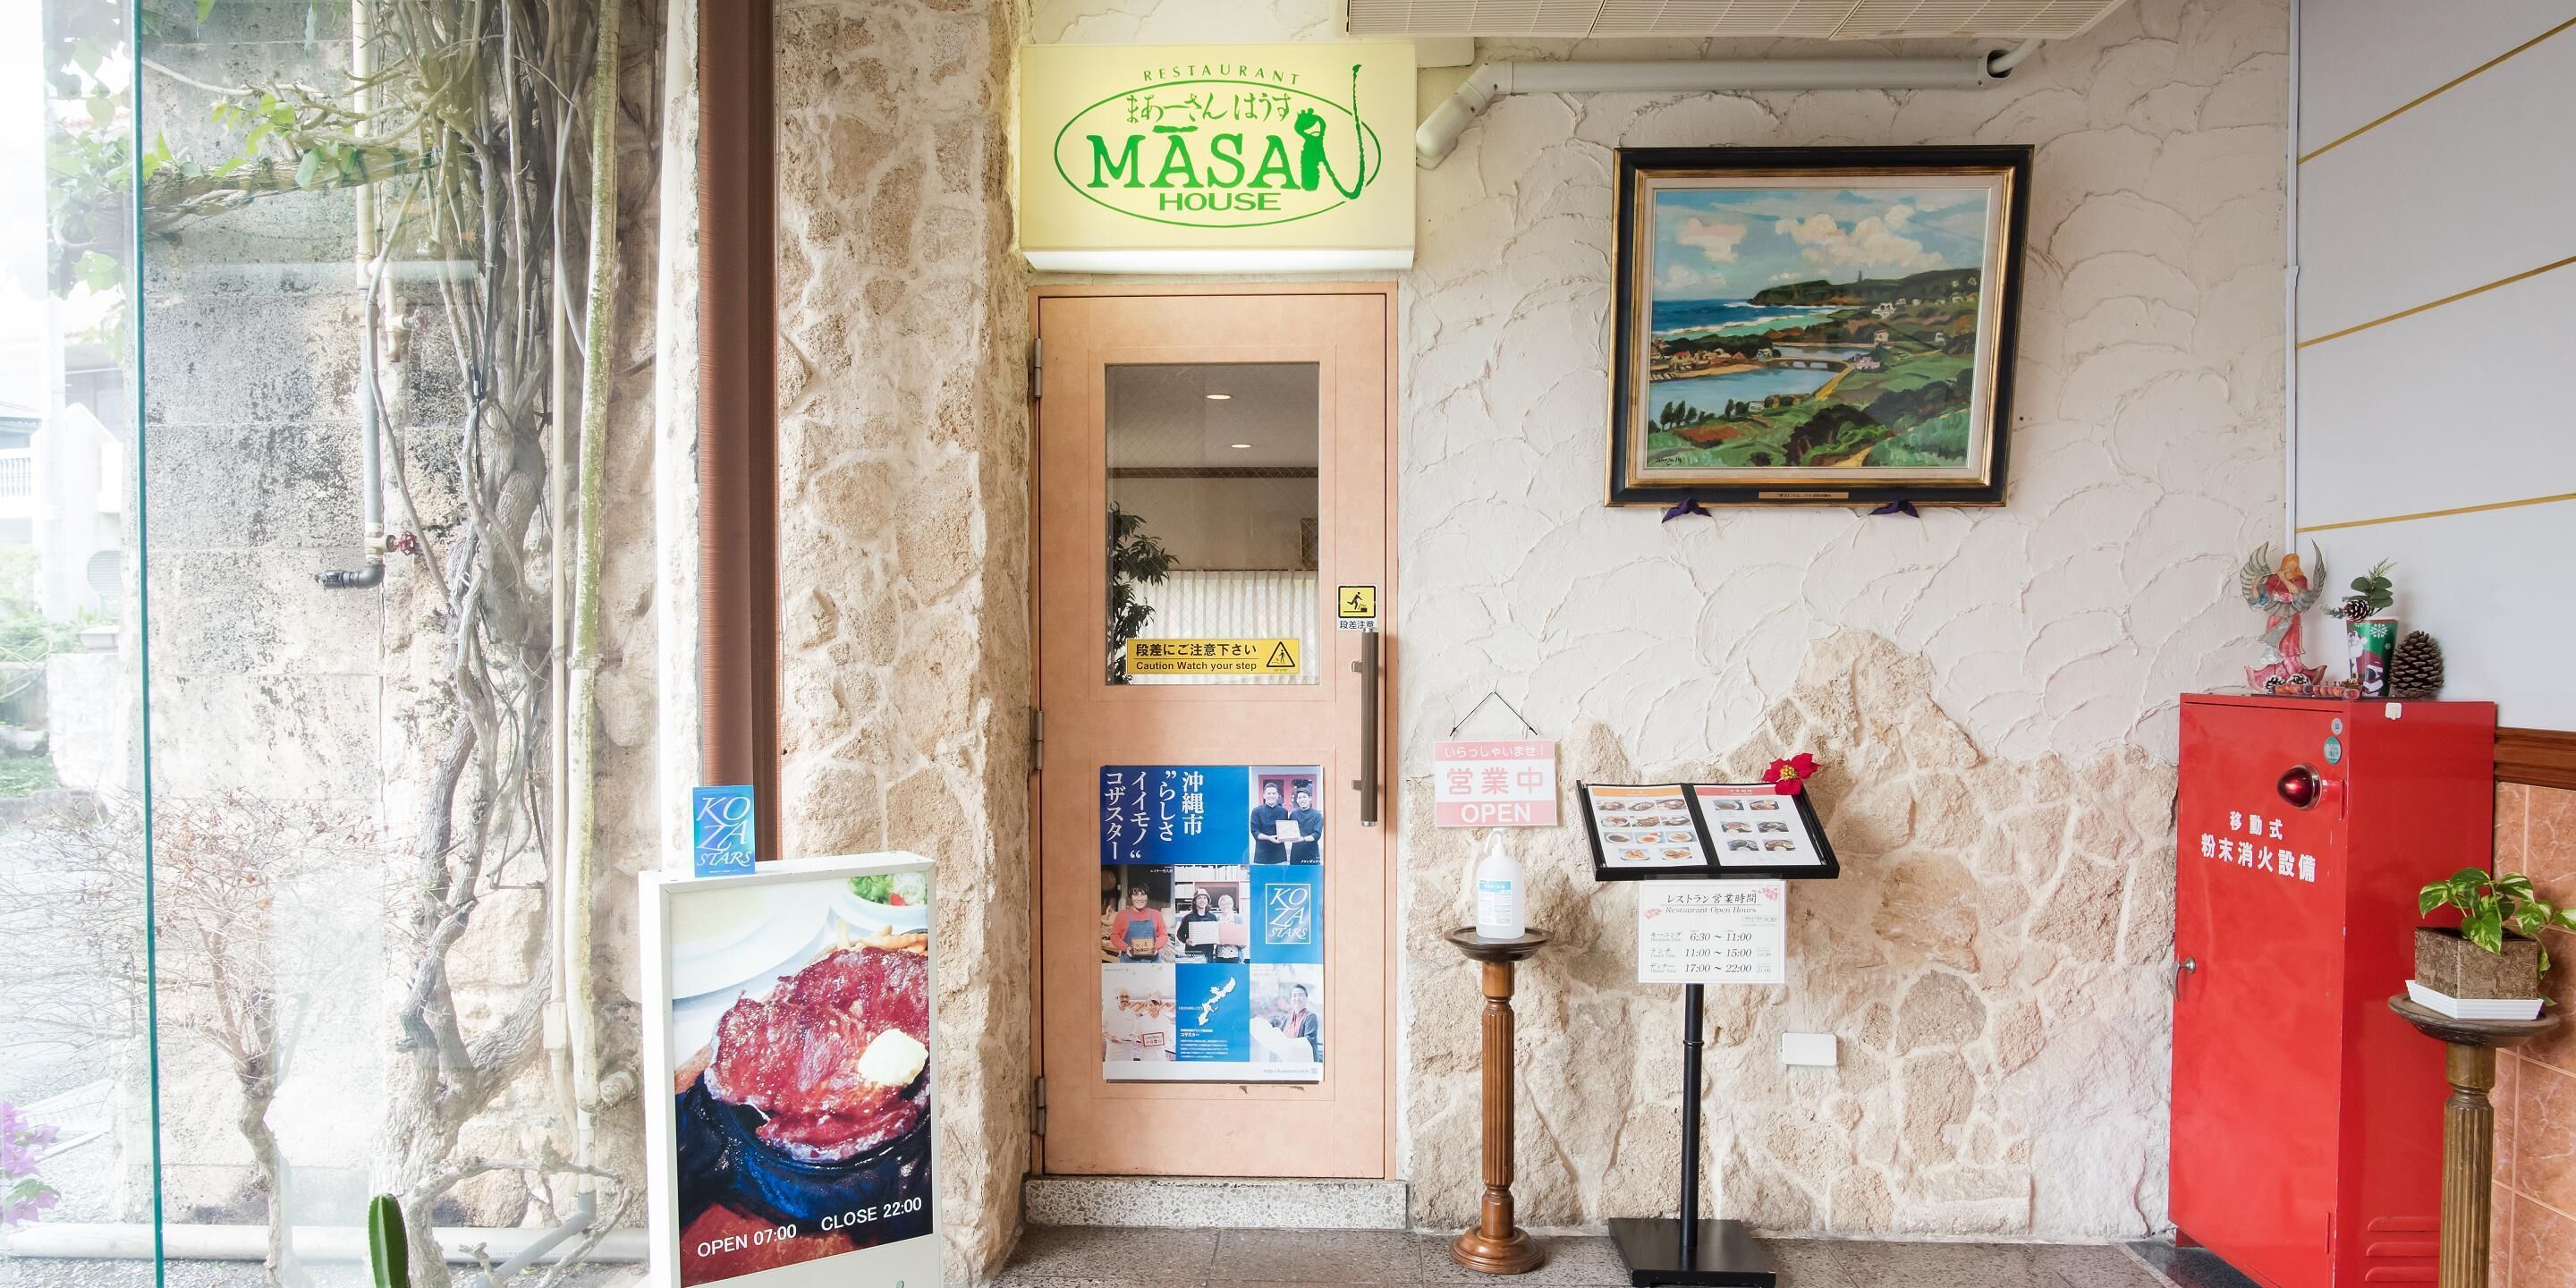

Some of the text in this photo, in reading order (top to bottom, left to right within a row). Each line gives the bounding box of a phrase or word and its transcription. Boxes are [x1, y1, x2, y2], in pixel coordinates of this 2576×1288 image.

[1143, 64, 1301, 85] RESTAURANT
[1159, 192, 1282, 211] HOUSE
[1136, 643, 1257, 657] 段差にご注意下さい
[1136, 661, 1257, 672] Caution Watch your step
[1446, 767, 1544, 795] 営業中
[696, 796, 751, 827] KO
[1182, 771, 1204, 836] 沖縄市
[1461, 803, 1530, 823] OPEN
[1105, 772, 1126, 860] コザスター
[2230, 810, 2284, 841] 移動式
[696, 819, 749, 852] ZA
[696, 851, 752, 868] STARS
[2201, 833, 2317, 883] 粉末消火設備
[1269, 887, 1308, 911] KO
[1667, 893, 1758, 904] レストラン営業時間
[1269, 907, 1305, 928] ZA
[1710, 906, 1731, 915] Open
[1268, 928, 1308, 940] STARS
[1690, 932, 1711, 942] 6:30
[1725, 932, 1752, 942] 11:00
[1685, 948, 1711, 958] 11:00
[1725, 948, 1752, 958] 15:00
[1685, 964, 1711, 973] 17:00
[1725, 964, 1752, 973] 22:00
[697, 1196, 922, 1258] OPEN 07:00 CLOSE 22:00
